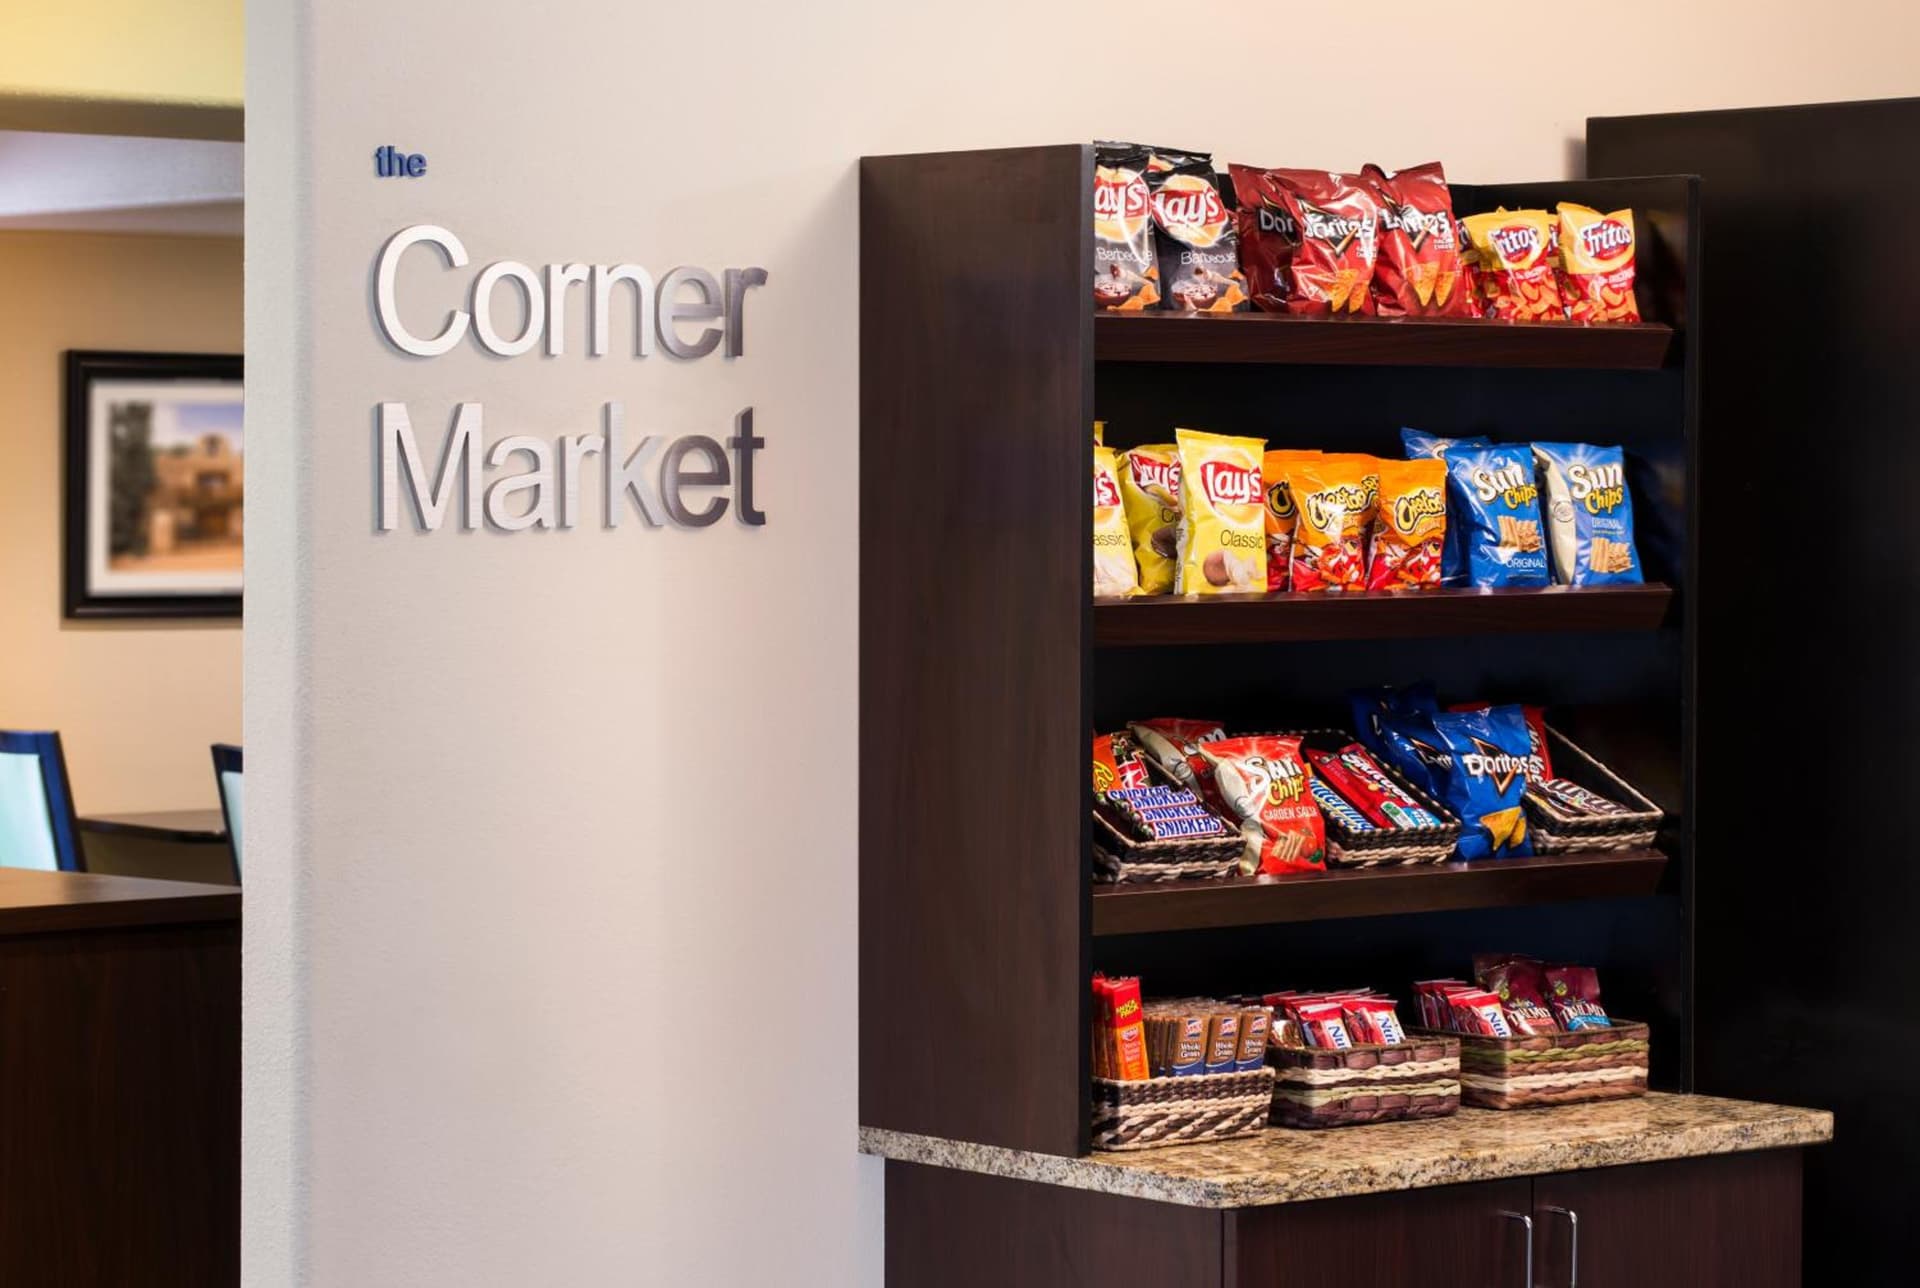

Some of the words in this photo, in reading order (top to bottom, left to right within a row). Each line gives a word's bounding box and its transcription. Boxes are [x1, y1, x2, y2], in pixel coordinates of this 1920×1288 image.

[374, 146, 427, 177] the
[1580, 219, 1631, 258] Fritos
[373, 224, 768, 359] Corner
[374, 401, 767, 531] Market
[1472, 459, 1526, 503] Sun
[1567, 462, 1623, 500] Sun
[1207, 463, 1262, 504] Lay's
[1503, 483, 1537, 510] Chips
[1584, 486, 1624, 515] Chips
[1220, 529, 1264, 549] Classic
[1462, 753, 1529, 776] Doritos
[1143, 804, 1206, 822] SNICKERS
[1155, 817, 1221, 837] SNICKERS
